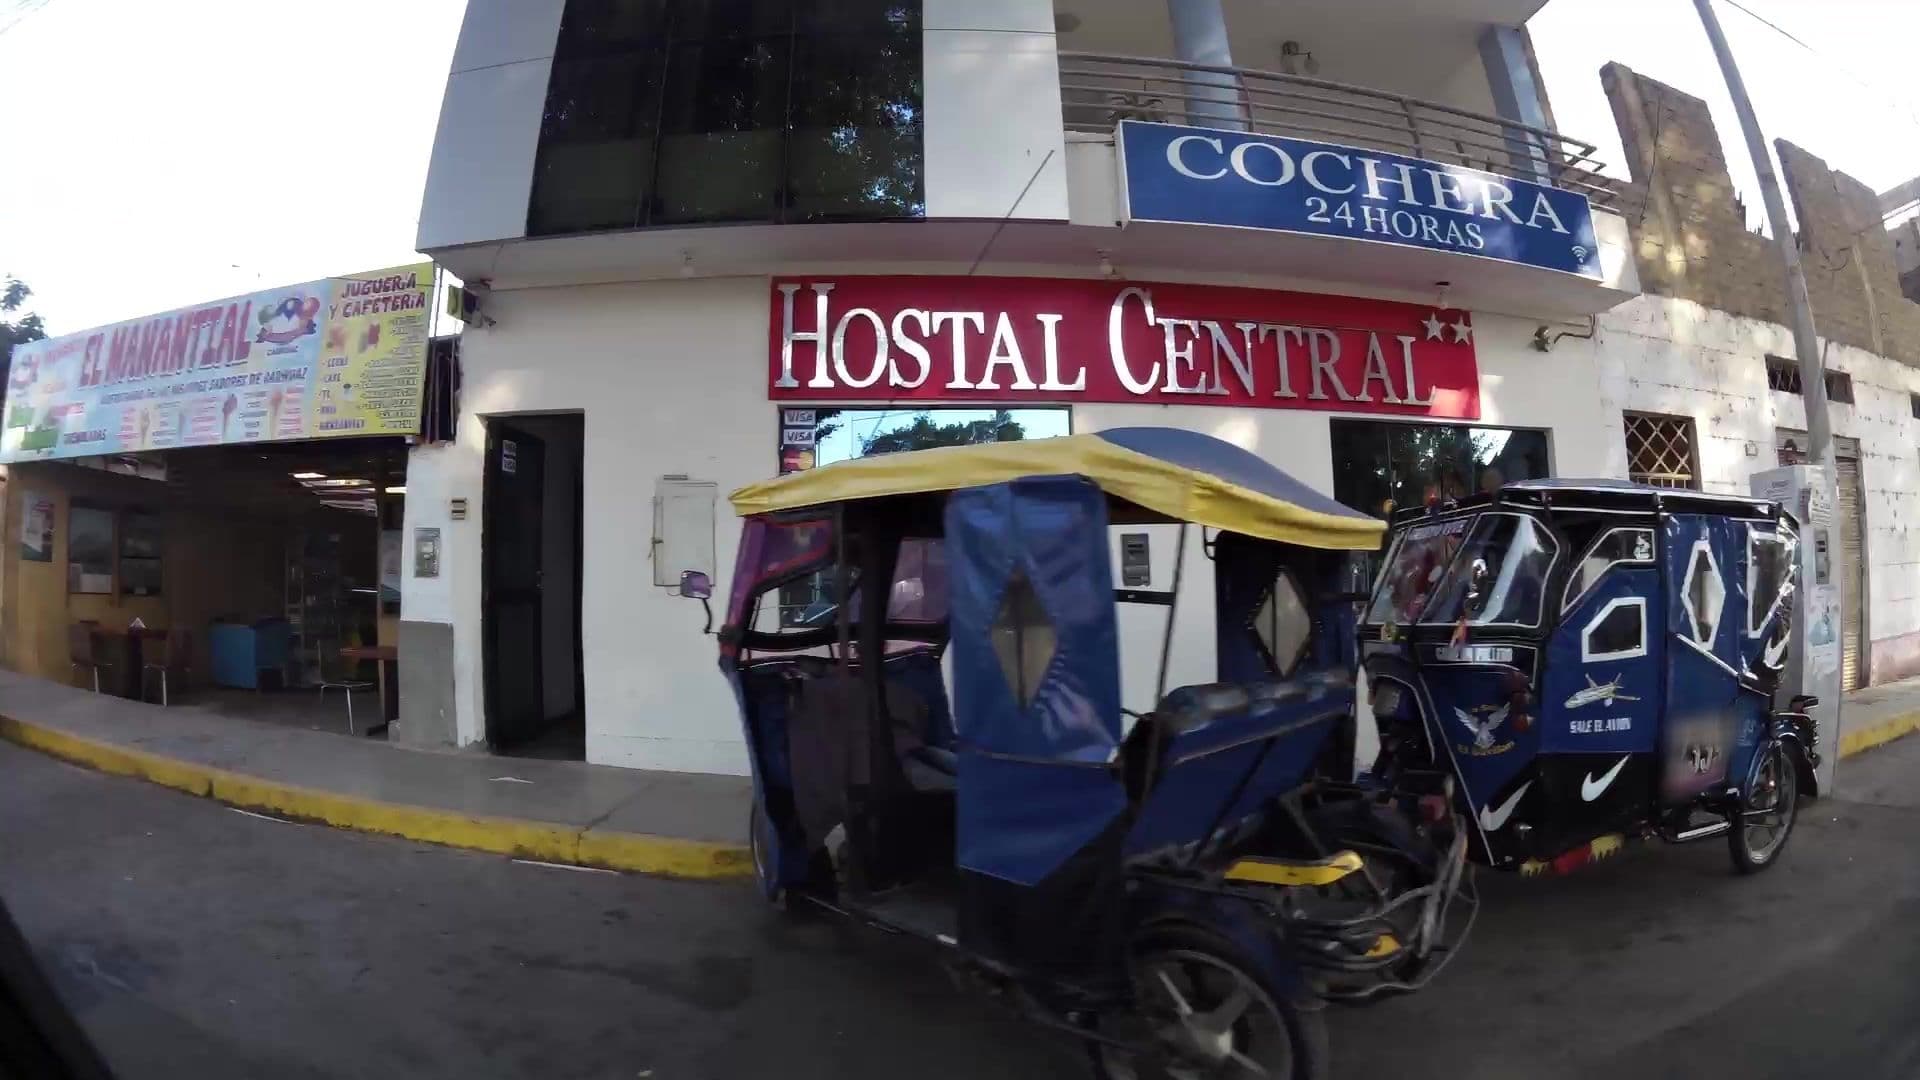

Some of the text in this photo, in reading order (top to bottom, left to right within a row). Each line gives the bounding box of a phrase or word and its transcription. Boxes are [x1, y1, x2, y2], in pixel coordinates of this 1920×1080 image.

[1166, 135, 1571, 235] COCHERA
[1305, 196, 1485, 250] 24 HORAS
[329, 304, 337, 320] Y
[79, 300, 251, 386] EL MANANTIAL
[786, 410, 813, 422] VISA
[787, 431, 812, 441] VISA
[1570, 720, 1592, 734] SALE
